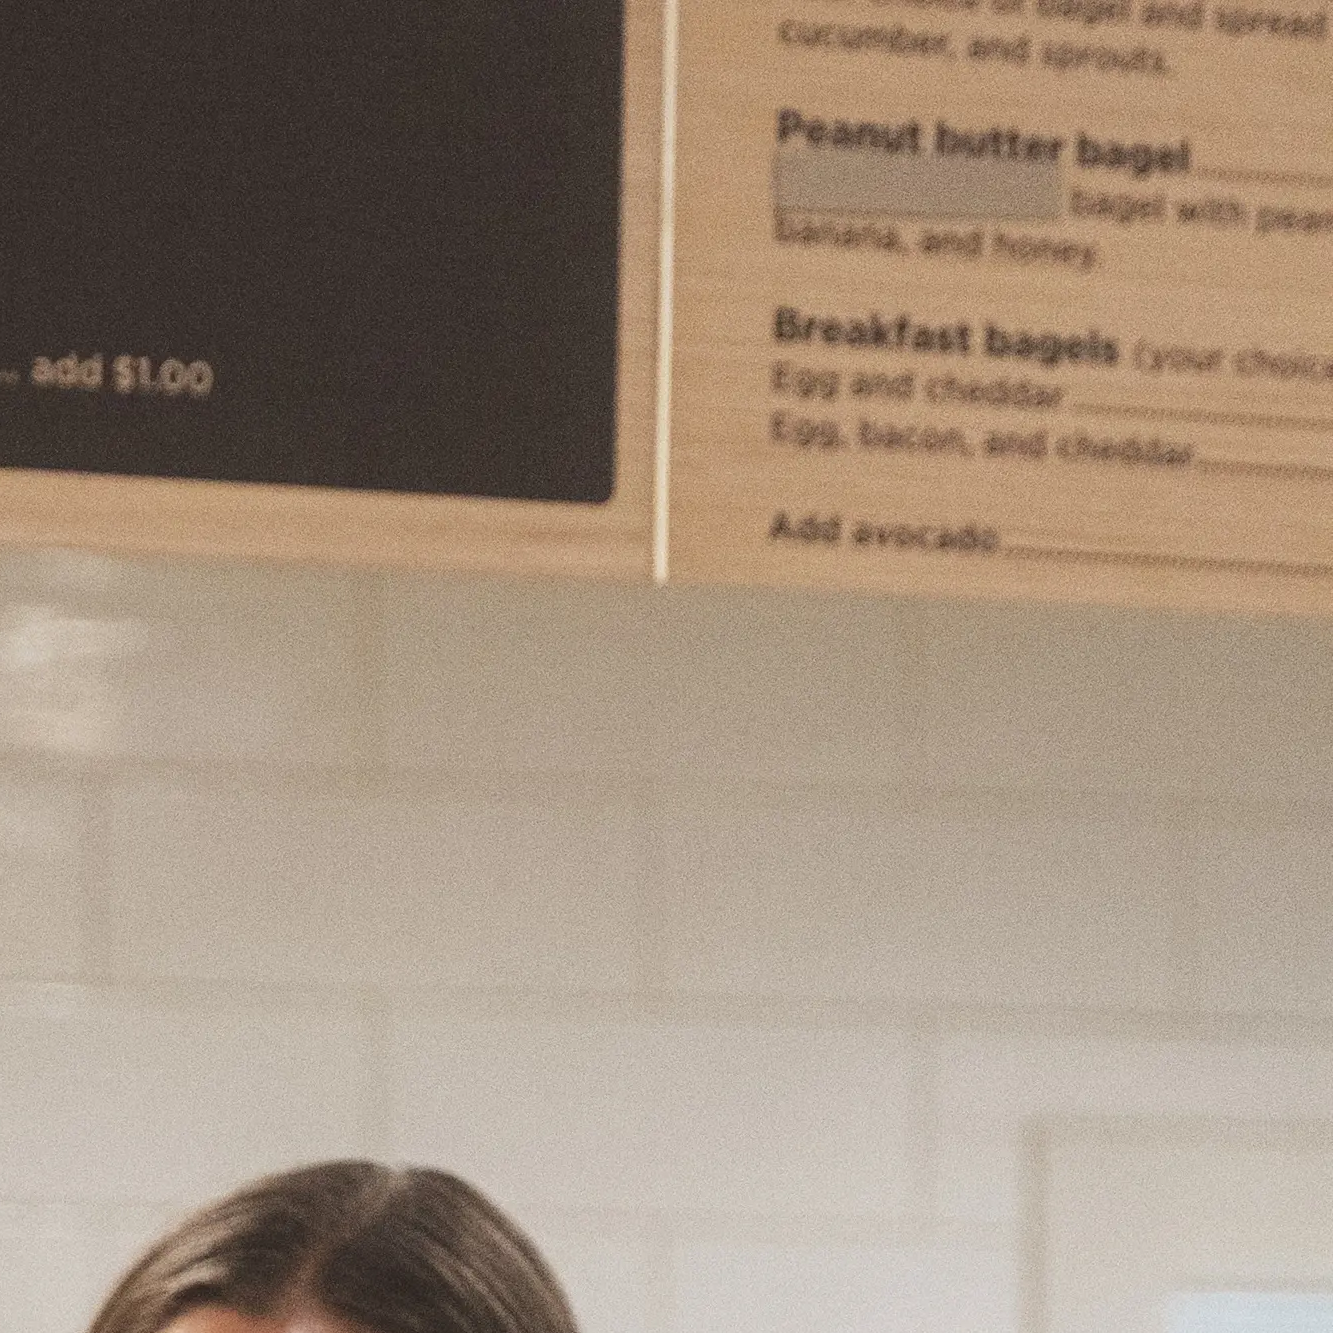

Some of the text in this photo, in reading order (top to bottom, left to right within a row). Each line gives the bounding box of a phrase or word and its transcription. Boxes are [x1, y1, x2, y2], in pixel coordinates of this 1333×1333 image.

[967, 36, 1030, 66] and
[775, 108, 1191, 179] Peanut butter bagel
[921, 231, 983, 257] and
[772, 306, 971, 356] Breakfast
[983, 323, 1120, 369] bagels
[31, 354, 103, 389] add
[113, 355, 213, 395] $1.00
[770, 361, 1063, 410] Egg and cheddar
[984, 432, 1047, 460] and
[768, 512, 999, 554] Add avocado
